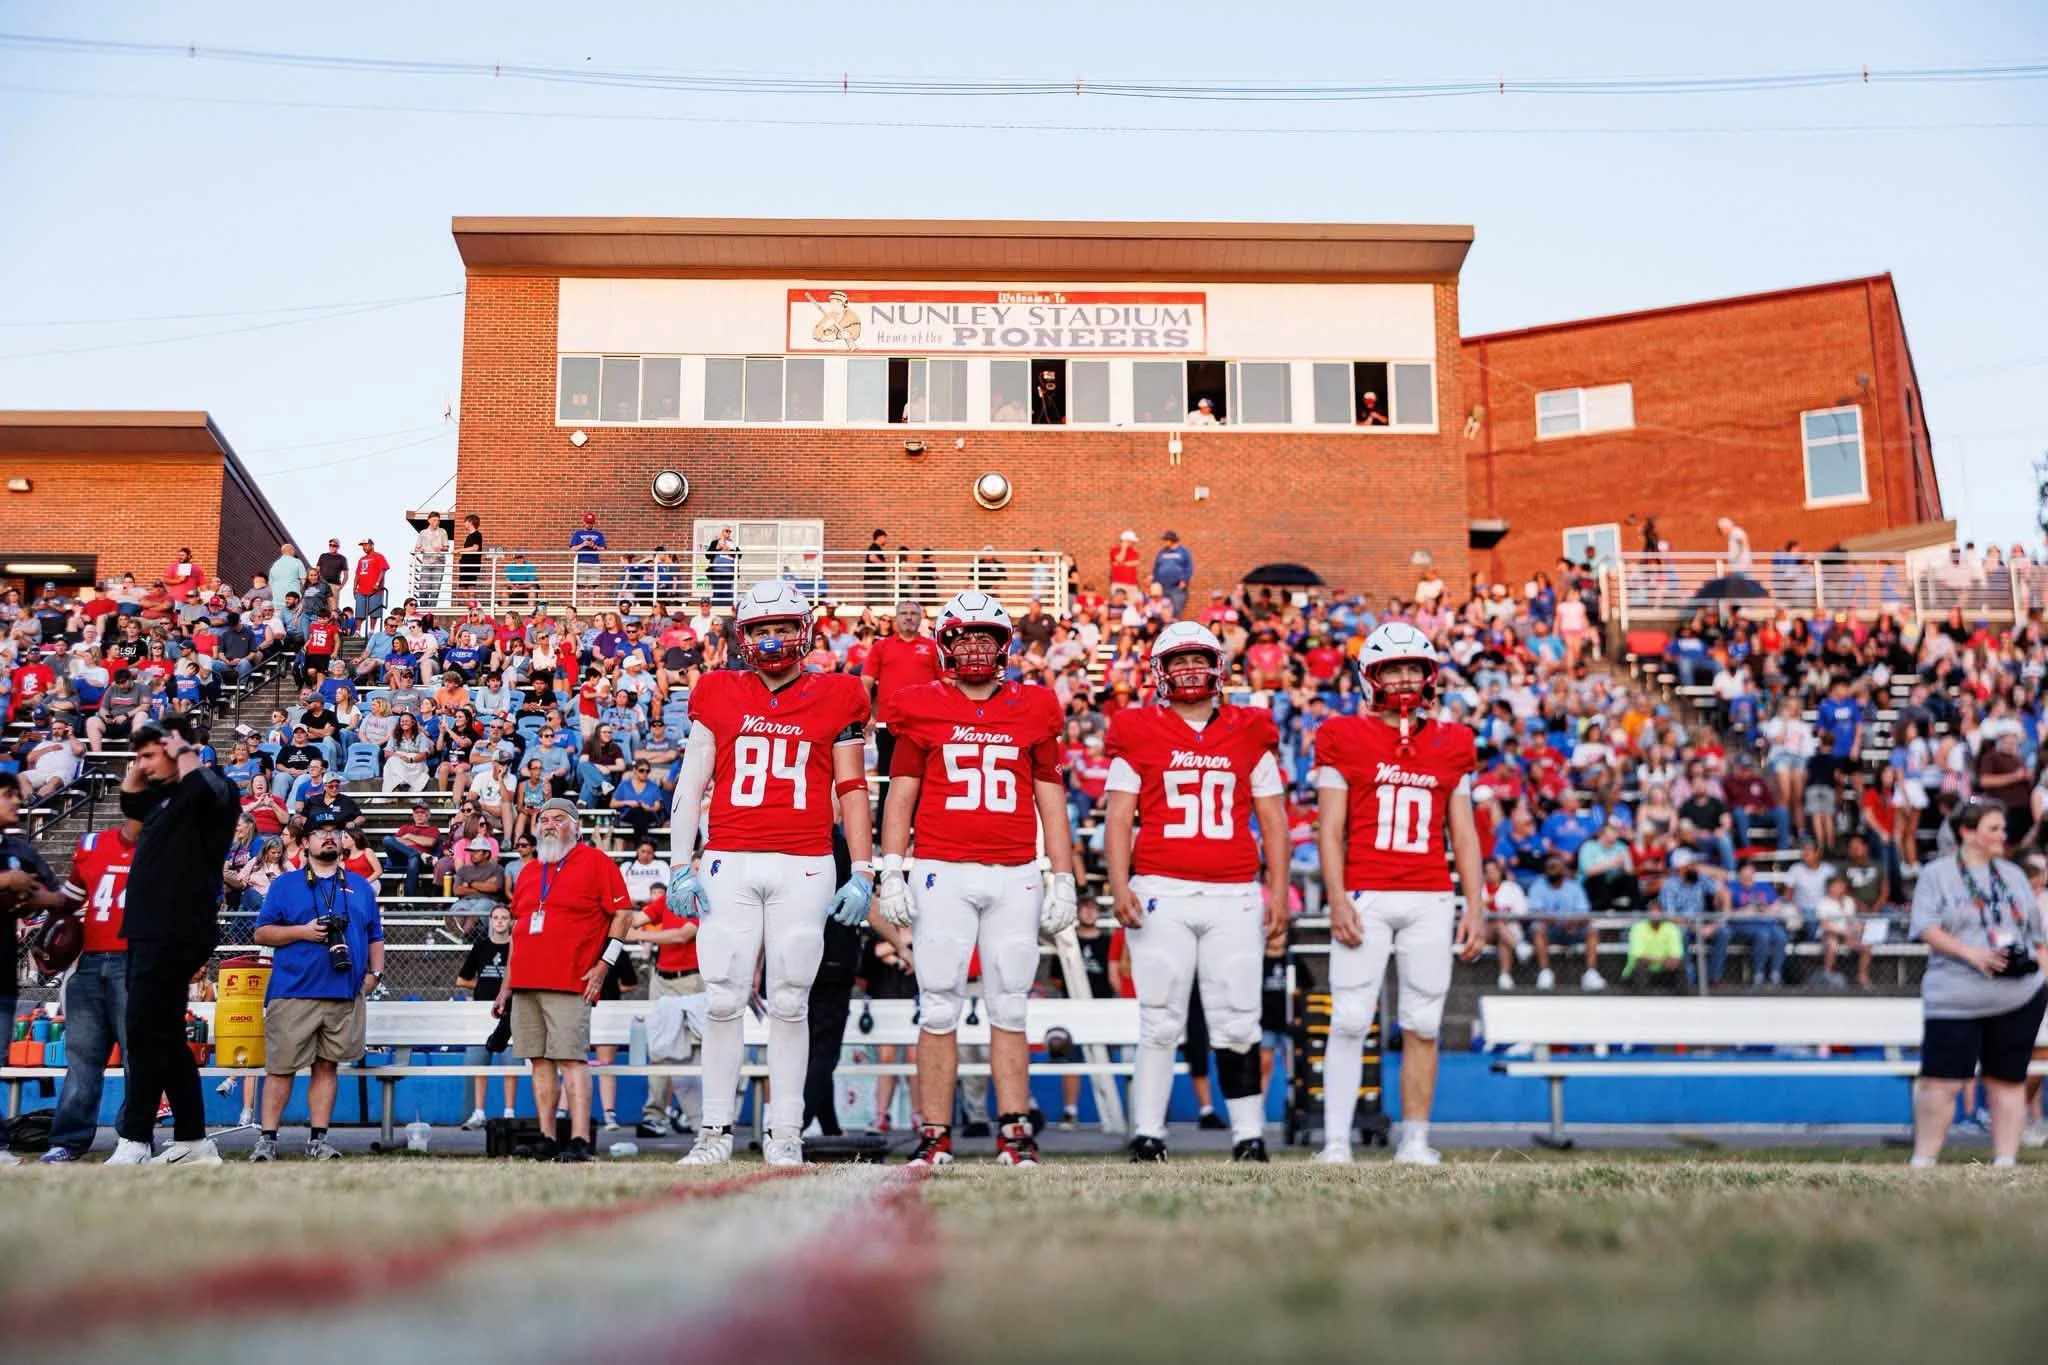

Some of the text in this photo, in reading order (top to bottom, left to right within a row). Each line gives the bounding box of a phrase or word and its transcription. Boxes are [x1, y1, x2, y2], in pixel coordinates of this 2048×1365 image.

[1054, 292, 1067, 304] To
[871, 305, 1193, 326] NUNLEY STADIUM
[951, 327, 1190, 348] PIONEERS
[312, 631, 328, 647] 15
[120, 646, 137, 655] LSU
[740, 714, 804, 735] Warren
[950, 725, 1013, 743] Warren
[1169, 749, 1232, 769] Warren
[730, 735, 812, 809] 84
[942, 743, 1019, 813] 56
[1374, 761, 1438, 788] Warren
[1162, 769, 1237, 840] 50
[1374, 784, 1433, 854] 10
